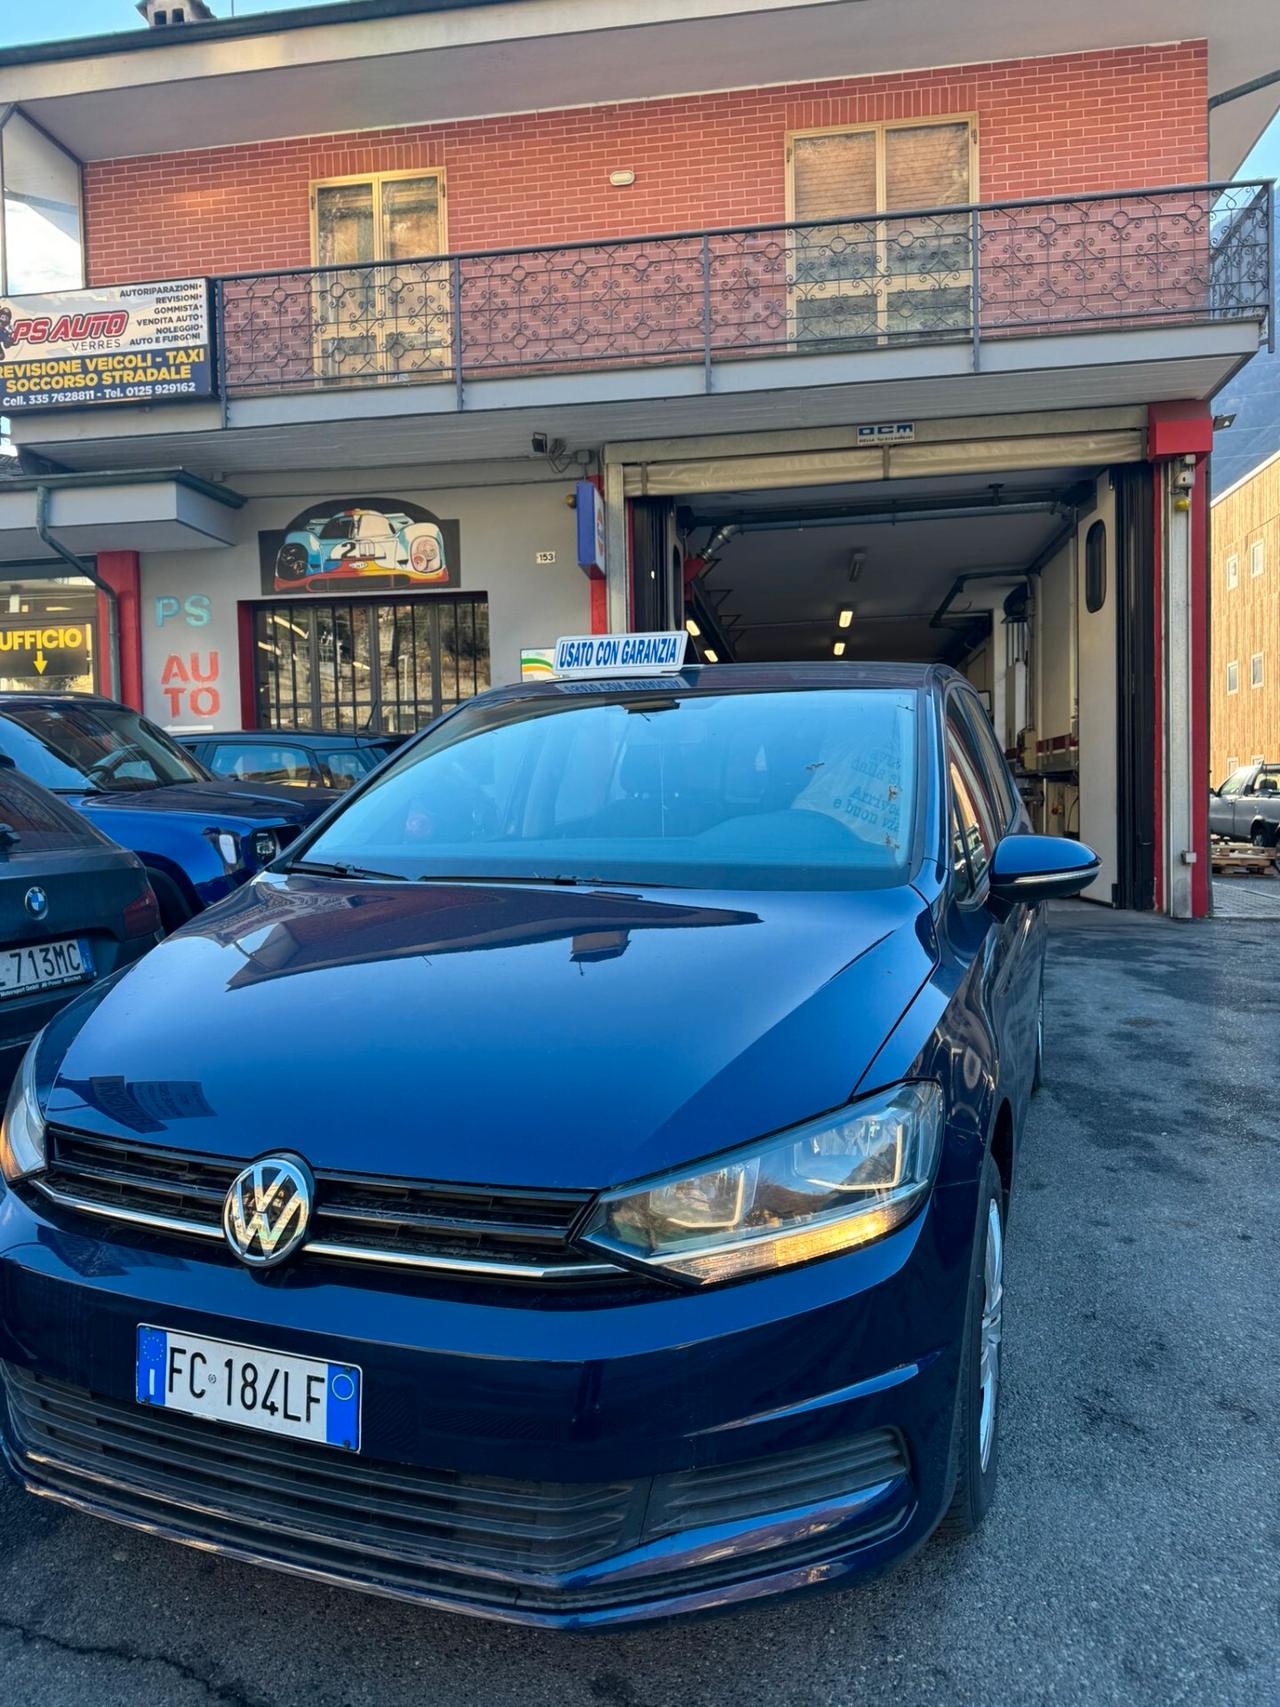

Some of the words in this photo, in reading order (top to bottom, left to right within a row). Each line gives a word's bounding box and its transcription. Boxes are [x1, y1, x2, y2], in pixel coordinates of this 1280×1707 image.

[120, 283, 199, 298] AUTORIPARAZIONI
[155, 294, 199, 304] REVISIONI
[154, 304, 199, 314] GOMMISTA
[13, 319, 49, 344] PS
[51, 311, 128, 342] AUTO
[136, 316, 174, 327] VENDITA
[176, 313, 199, 323] AUTO
[156, 324, 200, 335] NOLEGGIO
[72, 339, 121, 351] VERRES
[129, 336, 153, 346] AUTO
[155, 335, 160, 344] E
[162, 332, 201, 343] FURGONI
[85, 353, 152, 371] VEICOLI
[166, 348, 205, 365] TAXI
[6, 373, 98, 393] SOCCORSO
[102, 365, 192, 385] STRADALE
[3, 395, 26, 407] Cell.
[29, 393, 48, 405] 335
[51, 390, 95, 403] 7628811
[104, 387, 124, 398] Tel.
[126, 385, 152, 397] 0125
[155, 382, 196, 394] 929162
[539, 553, 554, 562] 153
[155, 595, 210, 628] PS
[0, 627, 82, 651] UFFICIO
[559, 641, 595, 668] USATO
[595, 640, 620, 666] CON
[621, 638, 677, 664] GARANZIA
[844, 796, 879, 825] buon
